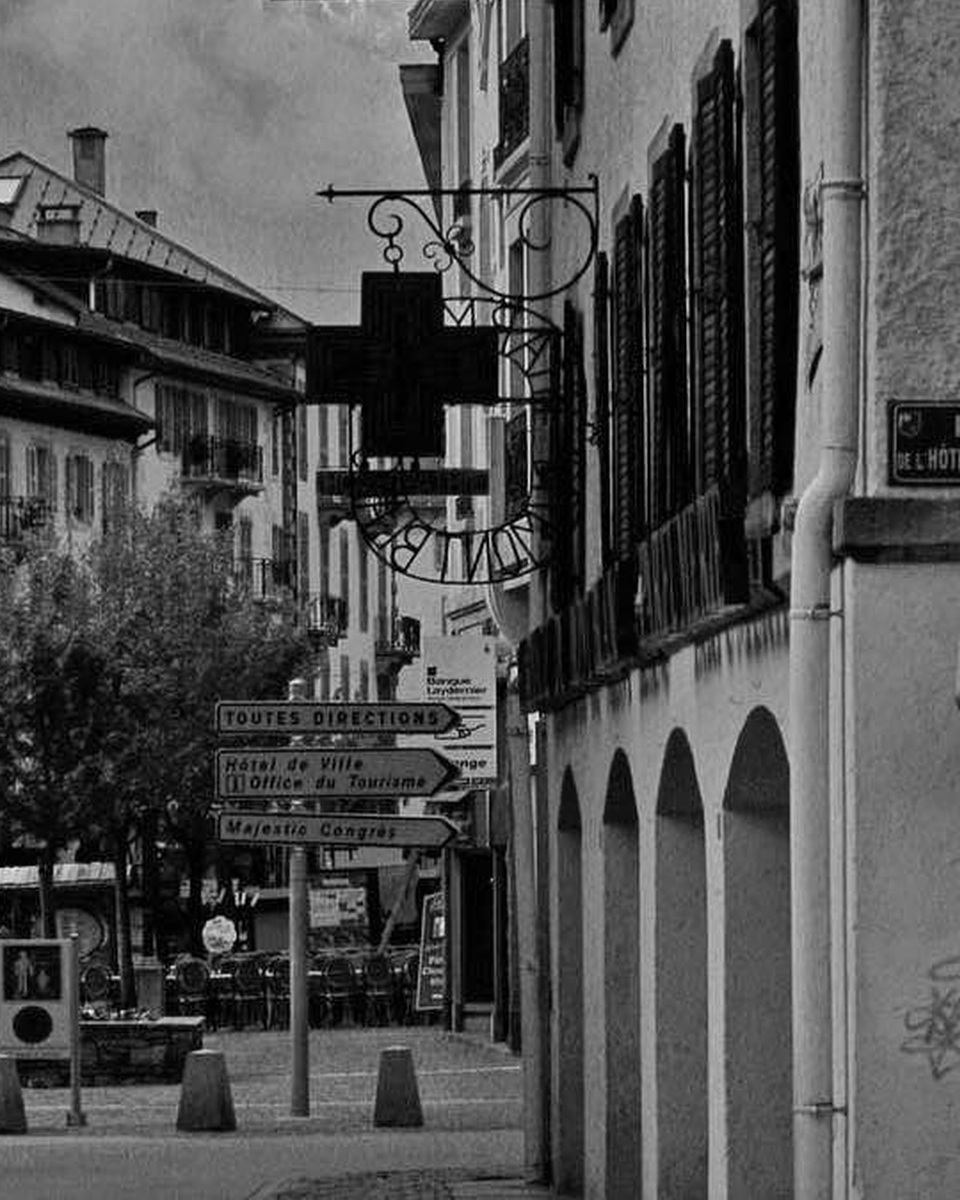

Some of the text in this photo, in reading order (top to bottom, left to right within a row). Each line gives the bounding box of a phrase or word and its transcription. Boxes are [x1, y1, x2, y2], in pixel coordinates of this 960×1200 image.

[914, 442, 960, 472] L'HÔT
[225, 710, 439, 726] TOUTES DIRECTIONS
[225, 756, 364, 773] Hôtel de Ville
[250, 774, 426, 790] Office du Tourisme
[225, 818, 307, 838] Majestic
